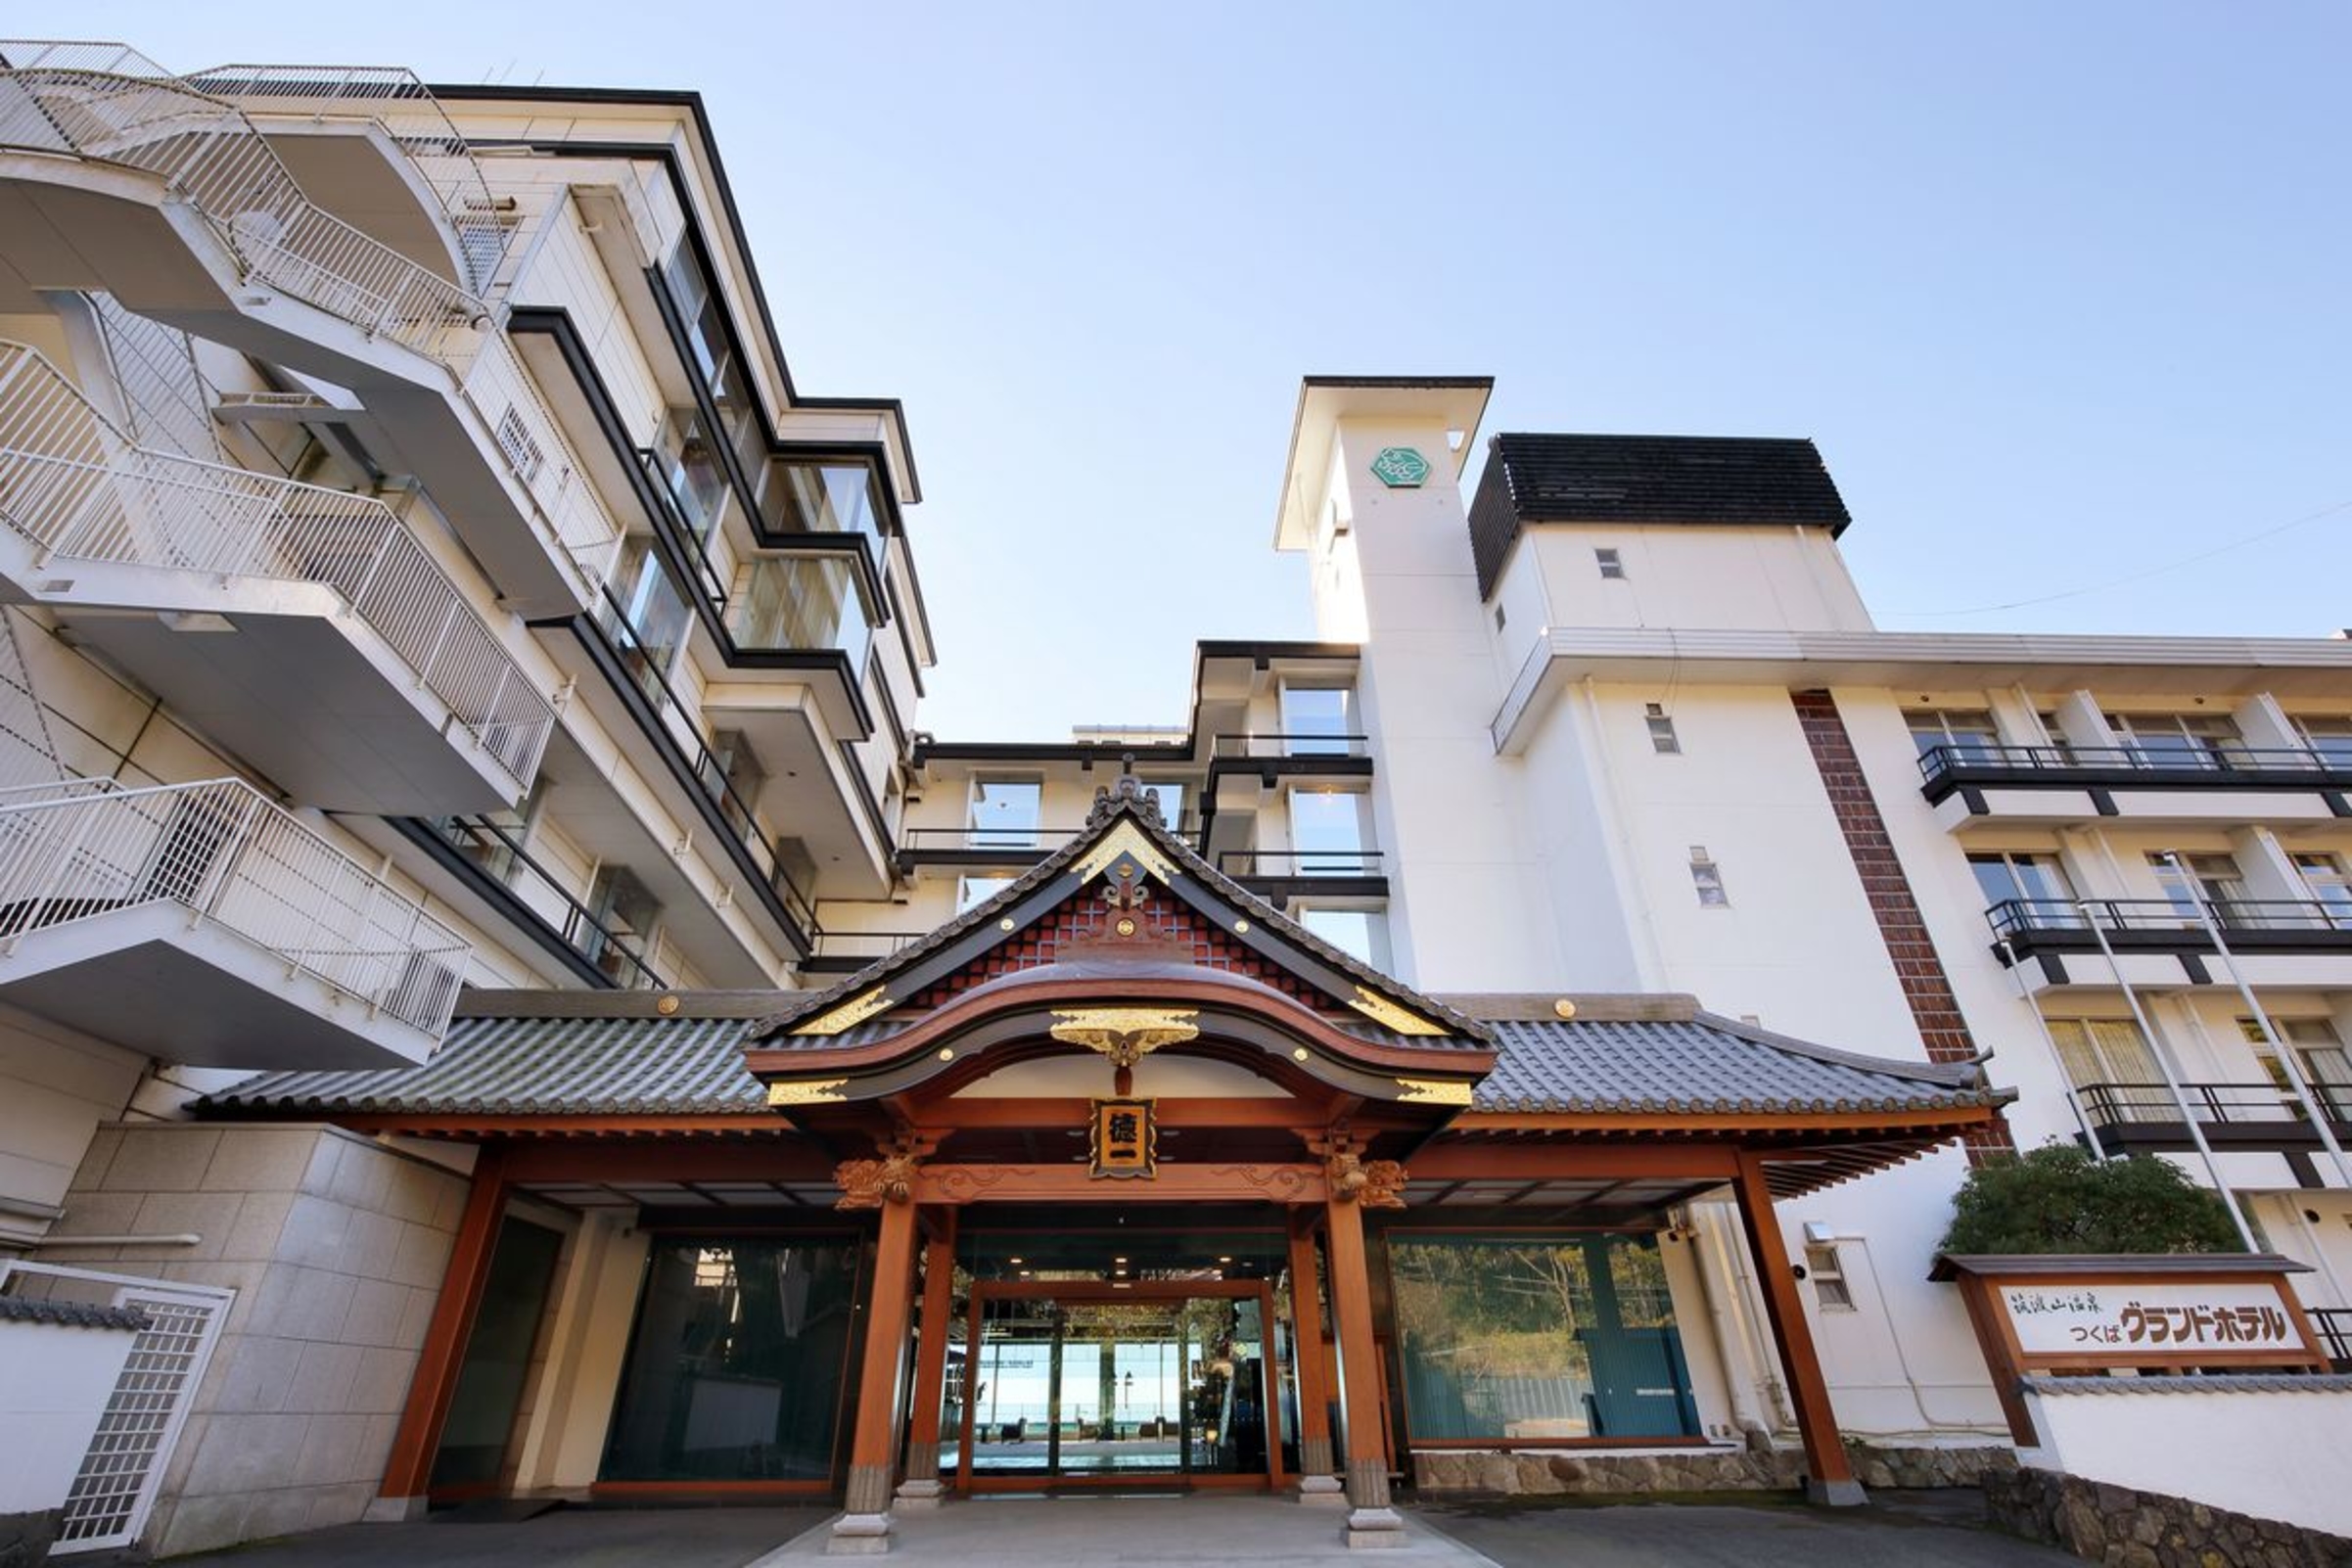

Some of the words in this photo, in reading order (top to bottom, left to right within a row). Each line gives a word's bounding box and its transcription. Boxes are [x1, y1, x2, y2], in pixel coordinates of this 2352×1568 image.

[2010, 1291, 2103, 1314] 筑波山温泉
